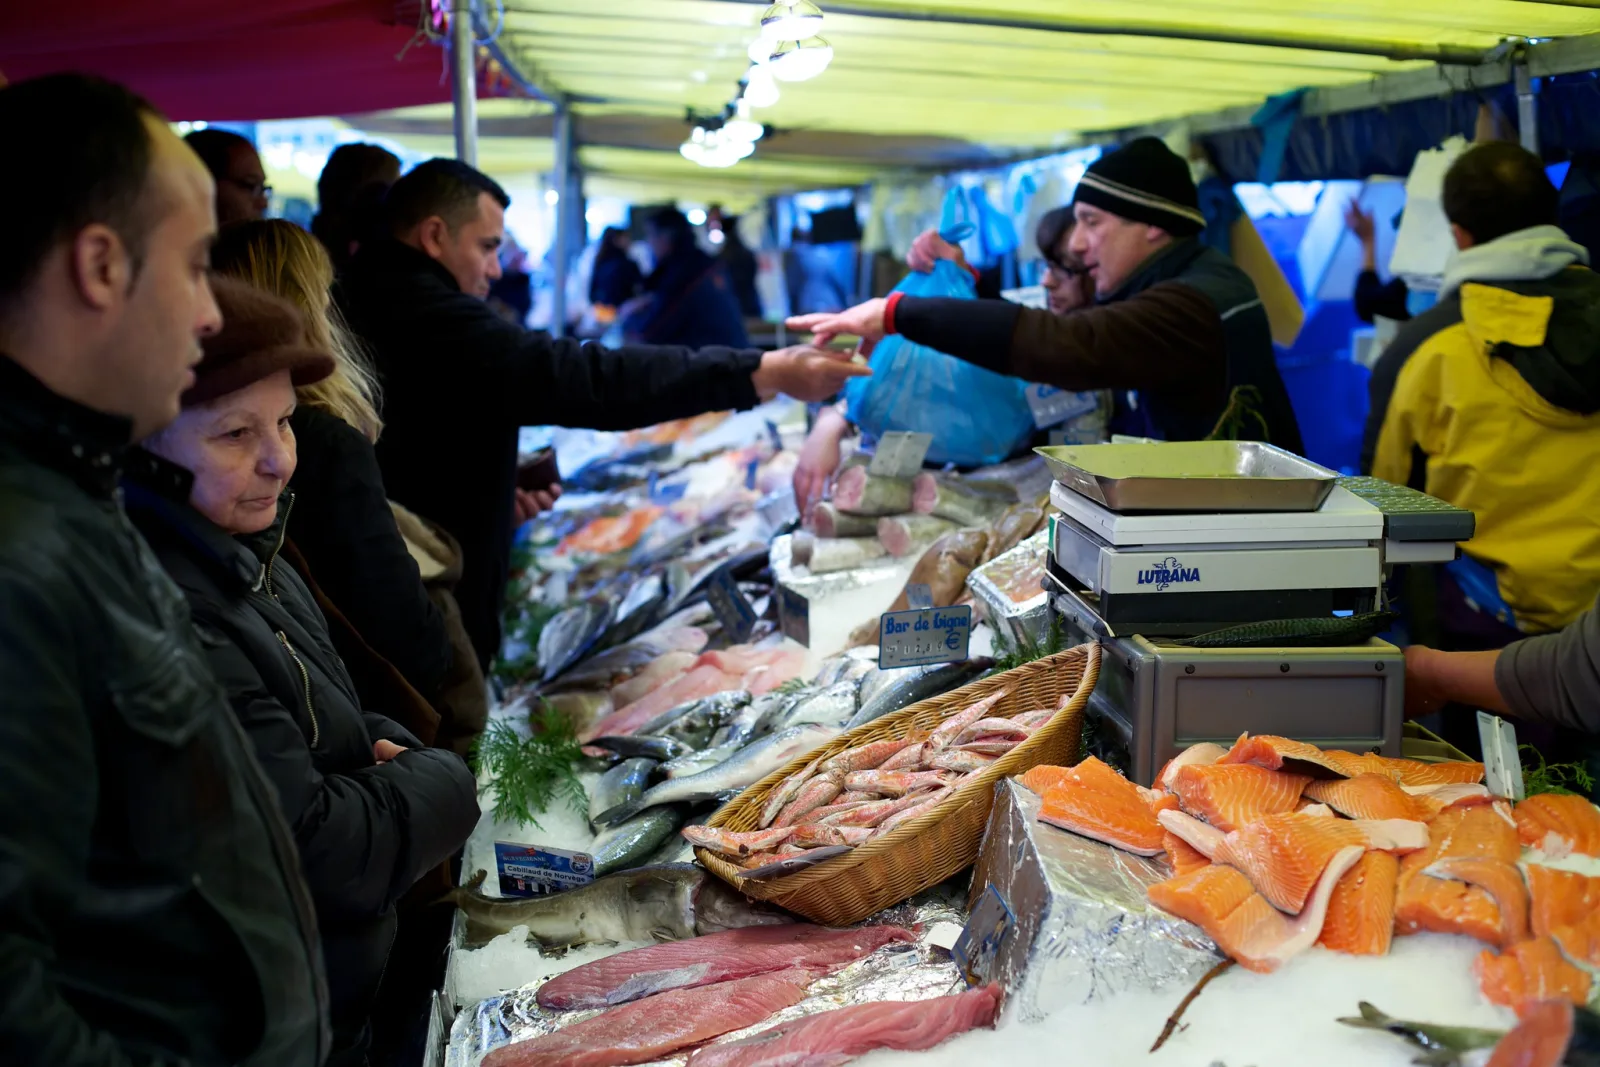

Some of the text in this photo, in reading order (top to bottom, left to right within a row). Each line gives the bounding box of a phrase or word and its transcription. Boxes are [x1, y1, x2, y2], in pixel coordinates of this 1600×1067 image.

[1137, 567, 1201, 585] LUTRANA
[885, 611, 968, 635] Bar de Ligne
[507, 865, 542, 877] Cabillaud
[543, 869, 553, 878] de
[554, 872, 586, 883] Norvège
